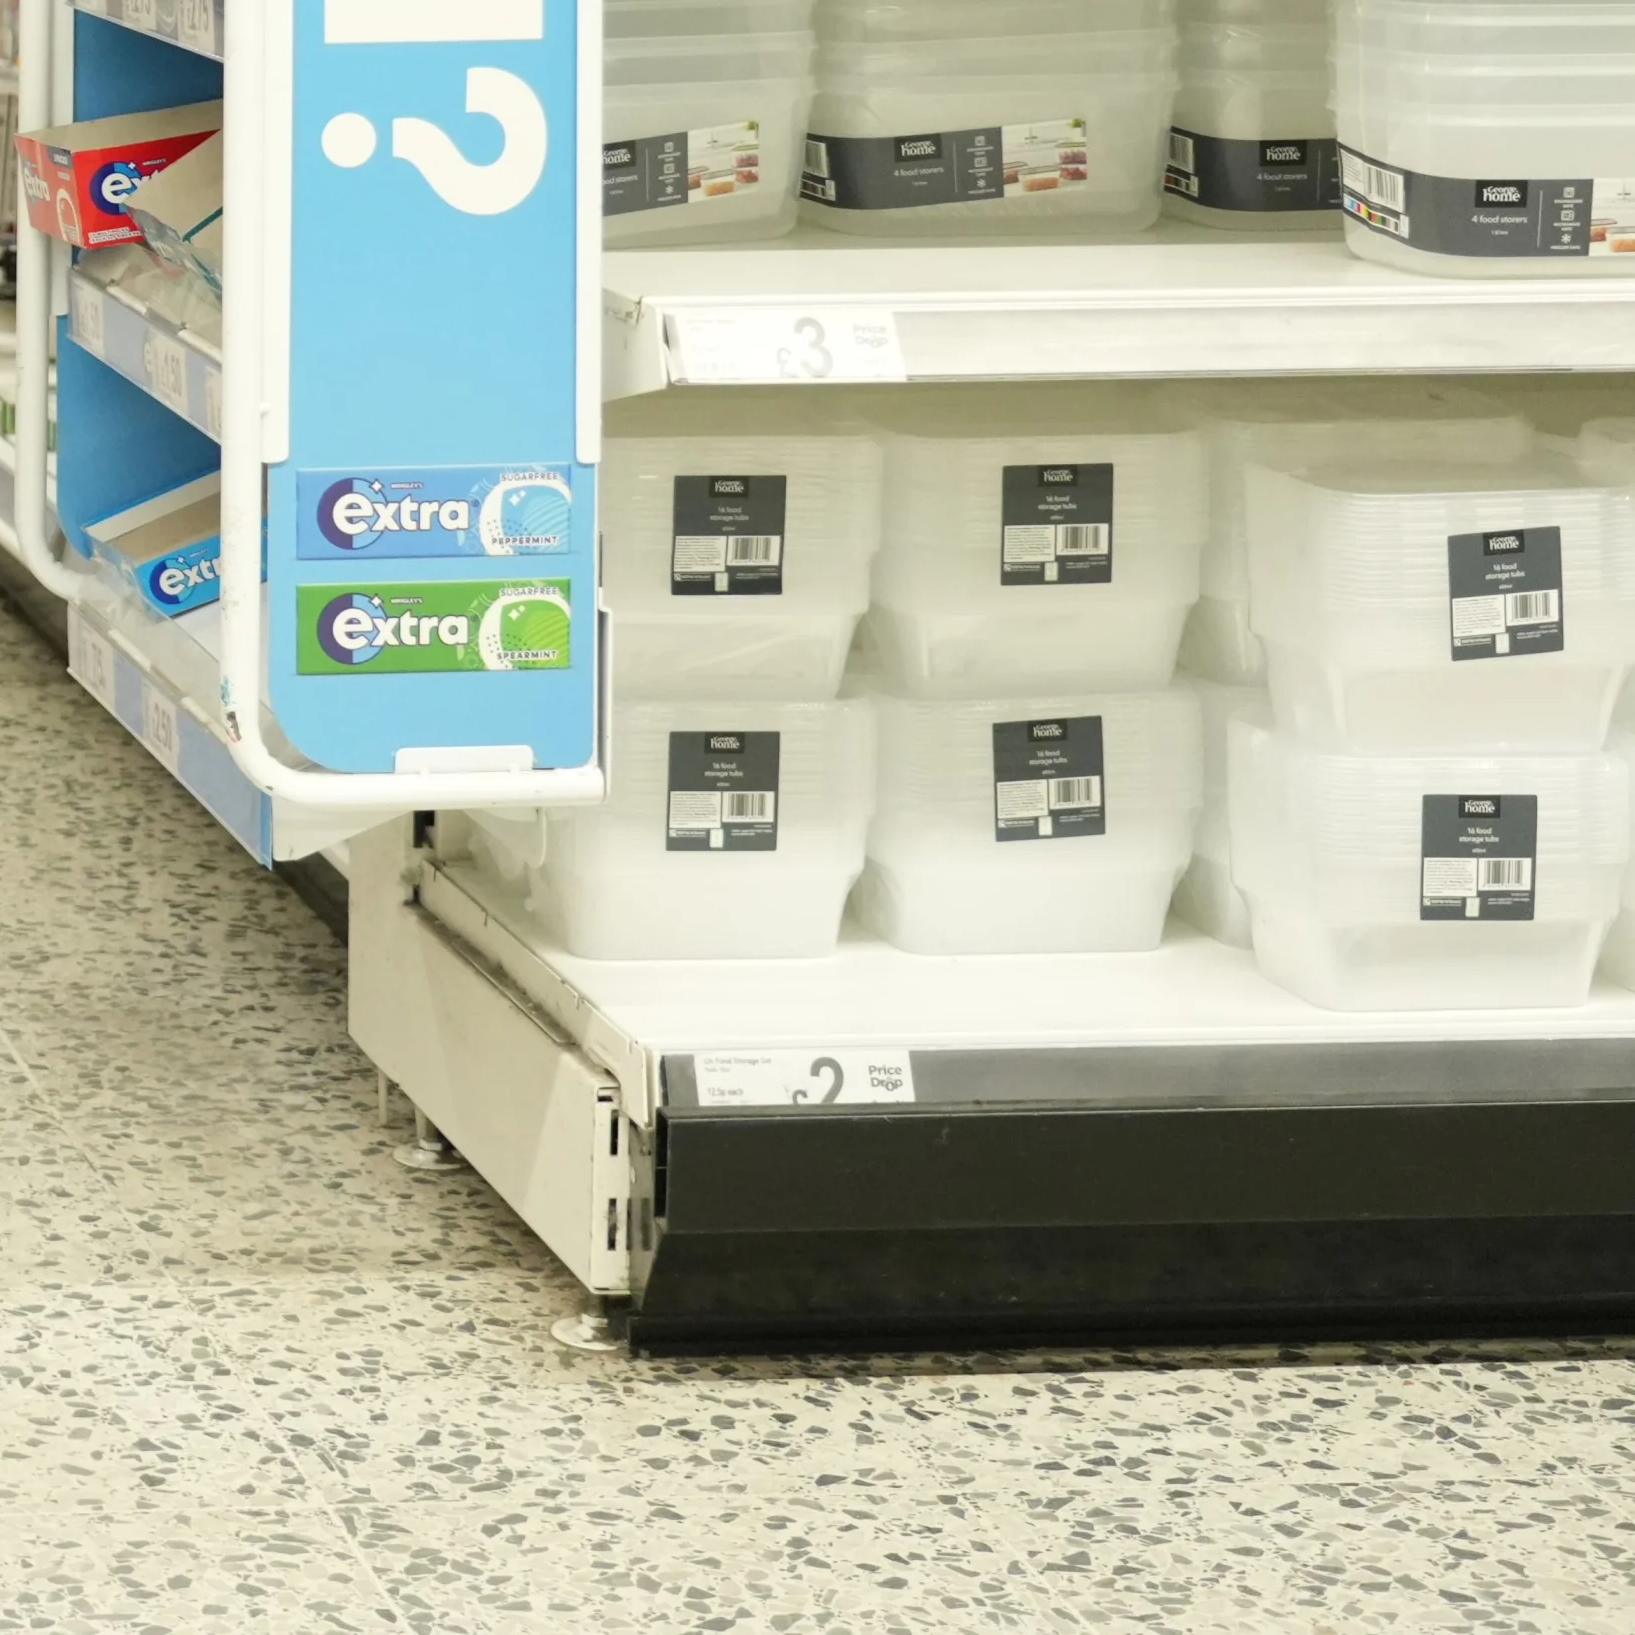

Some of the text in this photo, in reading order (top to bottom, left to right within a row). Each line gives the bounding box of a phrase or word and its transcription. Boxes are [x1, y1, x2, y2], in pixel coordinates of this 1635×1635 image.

[900, 142, 937, 157] home
[1265, 148, 1301, 161] home
[1489, 184, 1519, 193] George
[1482, 188, 1521, 203] home
[1479, 214, 1500, 225] food
[1500, 215, 1528, 224] storers
[775, 316, 834, 378] £3
[500, 470, 559, 482] SUGARFREE
[332, 493, 470, 536] extra
[491, 536, 558, 546] PEPPERMINT
[1489, 538, 1520, 551] home
[499, 586, 559, 597] SUGARFREE
[332, 608, 470, 651] extra
[496, 648, 558, 660] SPEARMINT
[1465, 801, 1496, 814] home
[868, 1064, 903, 1076] Price
[870, 1077, 904, 1092] Drop
